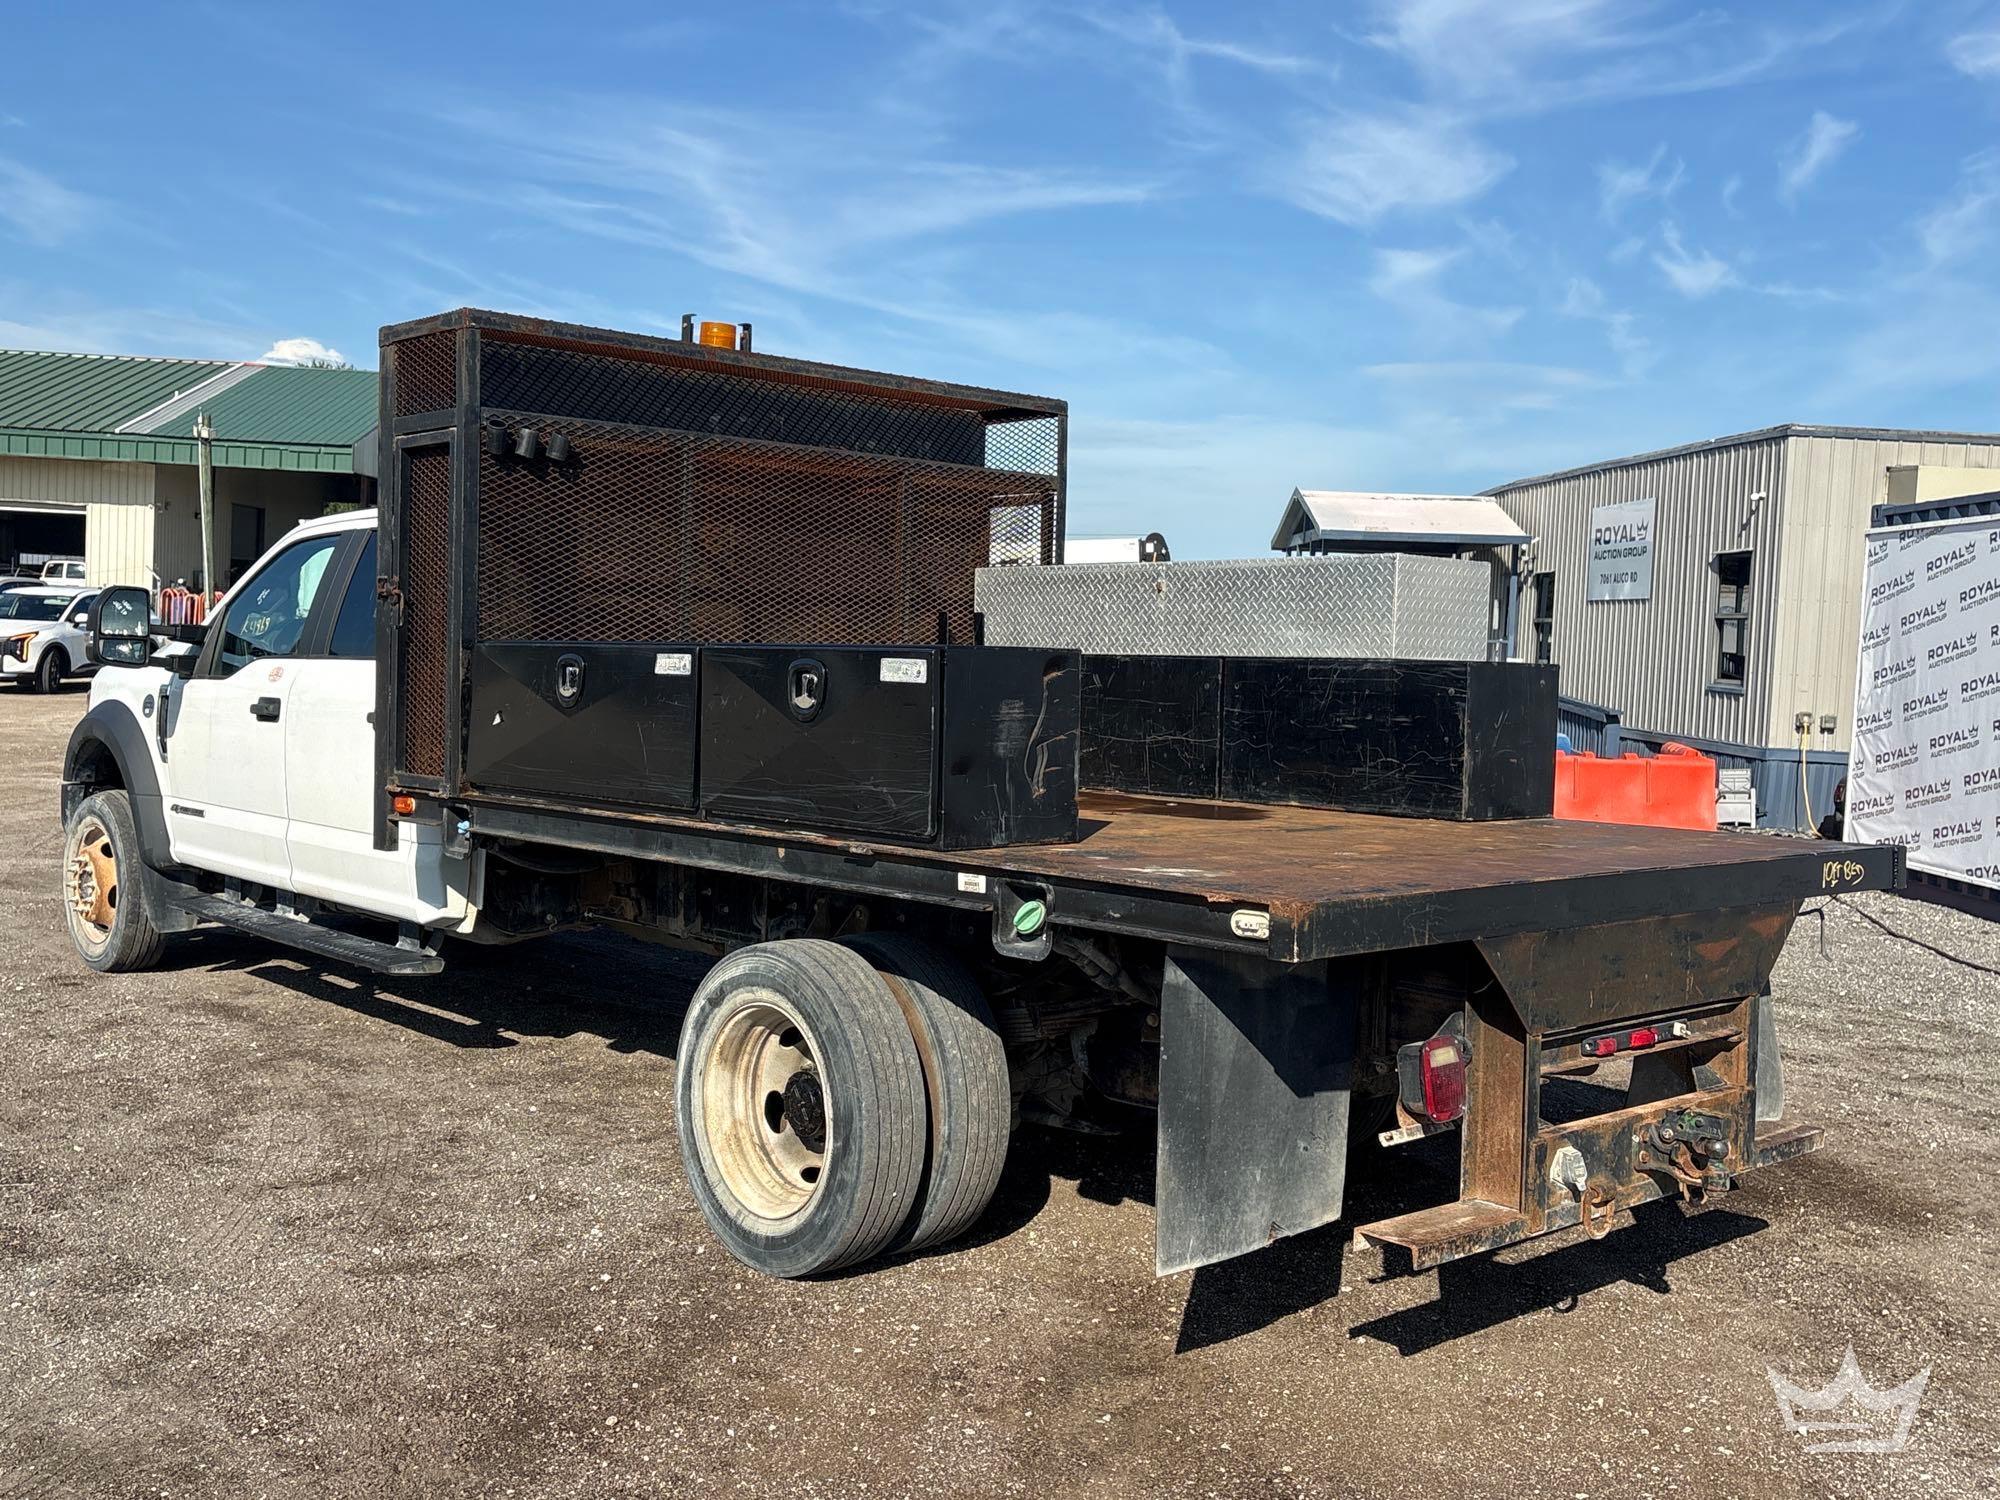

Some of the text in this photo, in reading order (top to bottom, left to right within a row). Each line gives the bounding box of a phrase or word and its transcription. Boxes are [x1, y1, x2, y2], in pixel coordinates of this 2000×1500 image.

[1595, 523, 1636, 546] ROYAL
[1594, 545, 1648, 560] AUCTION GROUP
[1926, 547, 1965, 573] ROYAL
[1600, 572, 1613, 584] 7061
[1630, 571, 1638, 583] RD
[1927, 555, 1976, 582] AUCTION GROUP
[1871, 576, 1906, 599] ROYAL
[1871, 582, 1916, 607] AUCTION GROUP
[1960, 578, 2000, 604] ROYAL
[1960, 596, 1989, 612] AUCTION
[1901, 601, 1937, 629] ROYAL
[1901, 613, 1948, 637] AUCTION GROUP
[1862, 629, 1881, 644] YAL
[1928, 637, 1966, 661] ROYAL
[1928, 647, 1977, 670] AUCTION GROUP
[1873, 660, 1907, 682] ROYAL
[1874, 669, 1917, 689] AUCTION GROUP
[1961, 672, 2000, 695] ROYAL
[1903, 693, 1939, 714] ROYAL
[1961, 689, 1990, 704] AUCTION
[1857, 712, 1883, 729] OYAL
[1904, 703, 1949, 722] AUCTION GROUP
[1929, 729, 1968, 750] ROYAL
[1930, 739, 1980, 759] AUCTION GROUP
[1875, 747, 1908, 765] ROYAL
[1876, 756, 1919, 774] AUCTION GROUP
[1852, 771, 1865, 779] OUP
[1964, 767, 2000, 787] ROYA
[1905, 782, 1941, 801] ROYAL
[1964, 782, 1992, 796] AUCTION
[1851, 796, 1885, 814] ROYAL
[1905, 793, 1952, 809] AUCTION GROUP
[1851, 806, 1895, 821] AUCTION GROUP
[1933, 821, 1971, 840] ROYAL
[1907, 845, 1921, 853] OUP
[1933, 833, 1983, 849] AUCTION GROUP
[1965, 864, 2000, 879] ROYA
